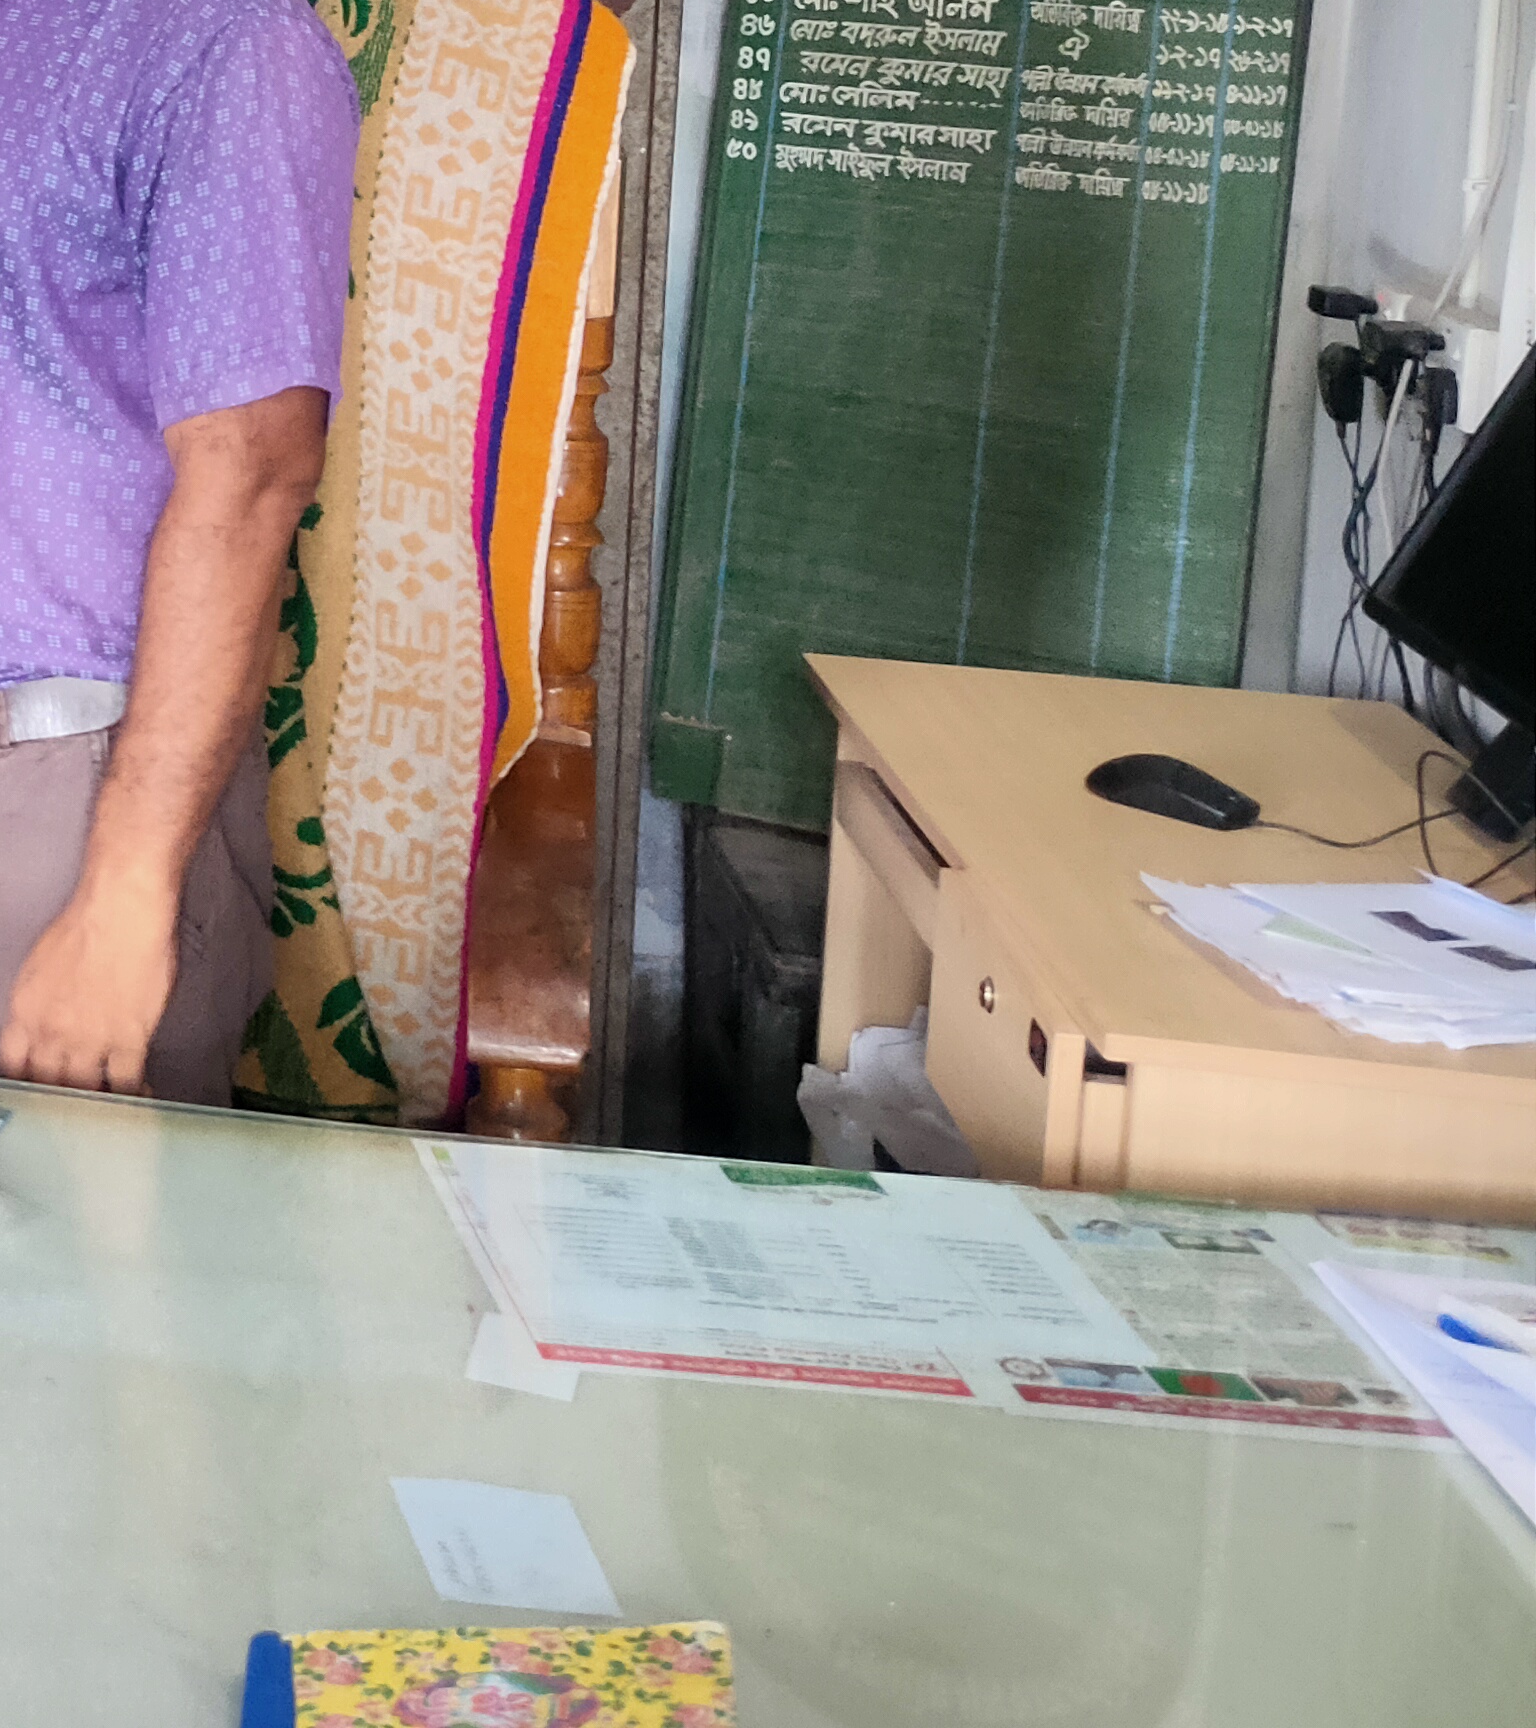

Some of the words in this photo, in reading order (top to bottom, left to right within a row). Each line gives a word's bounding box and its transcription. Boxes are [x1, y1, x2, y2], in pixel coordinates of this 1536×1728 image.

[740, 14, 776, 35] ৪৬
[790, 19, 838, 41] মোঃ
[841, 21, 922, 49] বদরুল
[923, 19, 1008, 56] ইসলাম
[1058, 29, 1091, 61] ঐ
[733, 78, 764, 100] ৪৮
[779, 81, 830, 104] মোঃ
[832, 81, 921, 111] সেলিম
[738, 47, 771, 71] ৪৭
[800, 51, 877, 79] রমেন
[878, 58, 959, 87] কুমার
[956, 64, 1013, 99] সাহা
[730, 109, 759, 130] ৪৯
[779, 112, 861, 138] রমেন
[864, 121, 939, 149] কুমার
[937, 125, 998, 154] সাহা
[726, 138, 757, 160] ৫০
[827, 142, 895, 181] সাইফুল
[895, 146, 972, 183] ইসলাম
